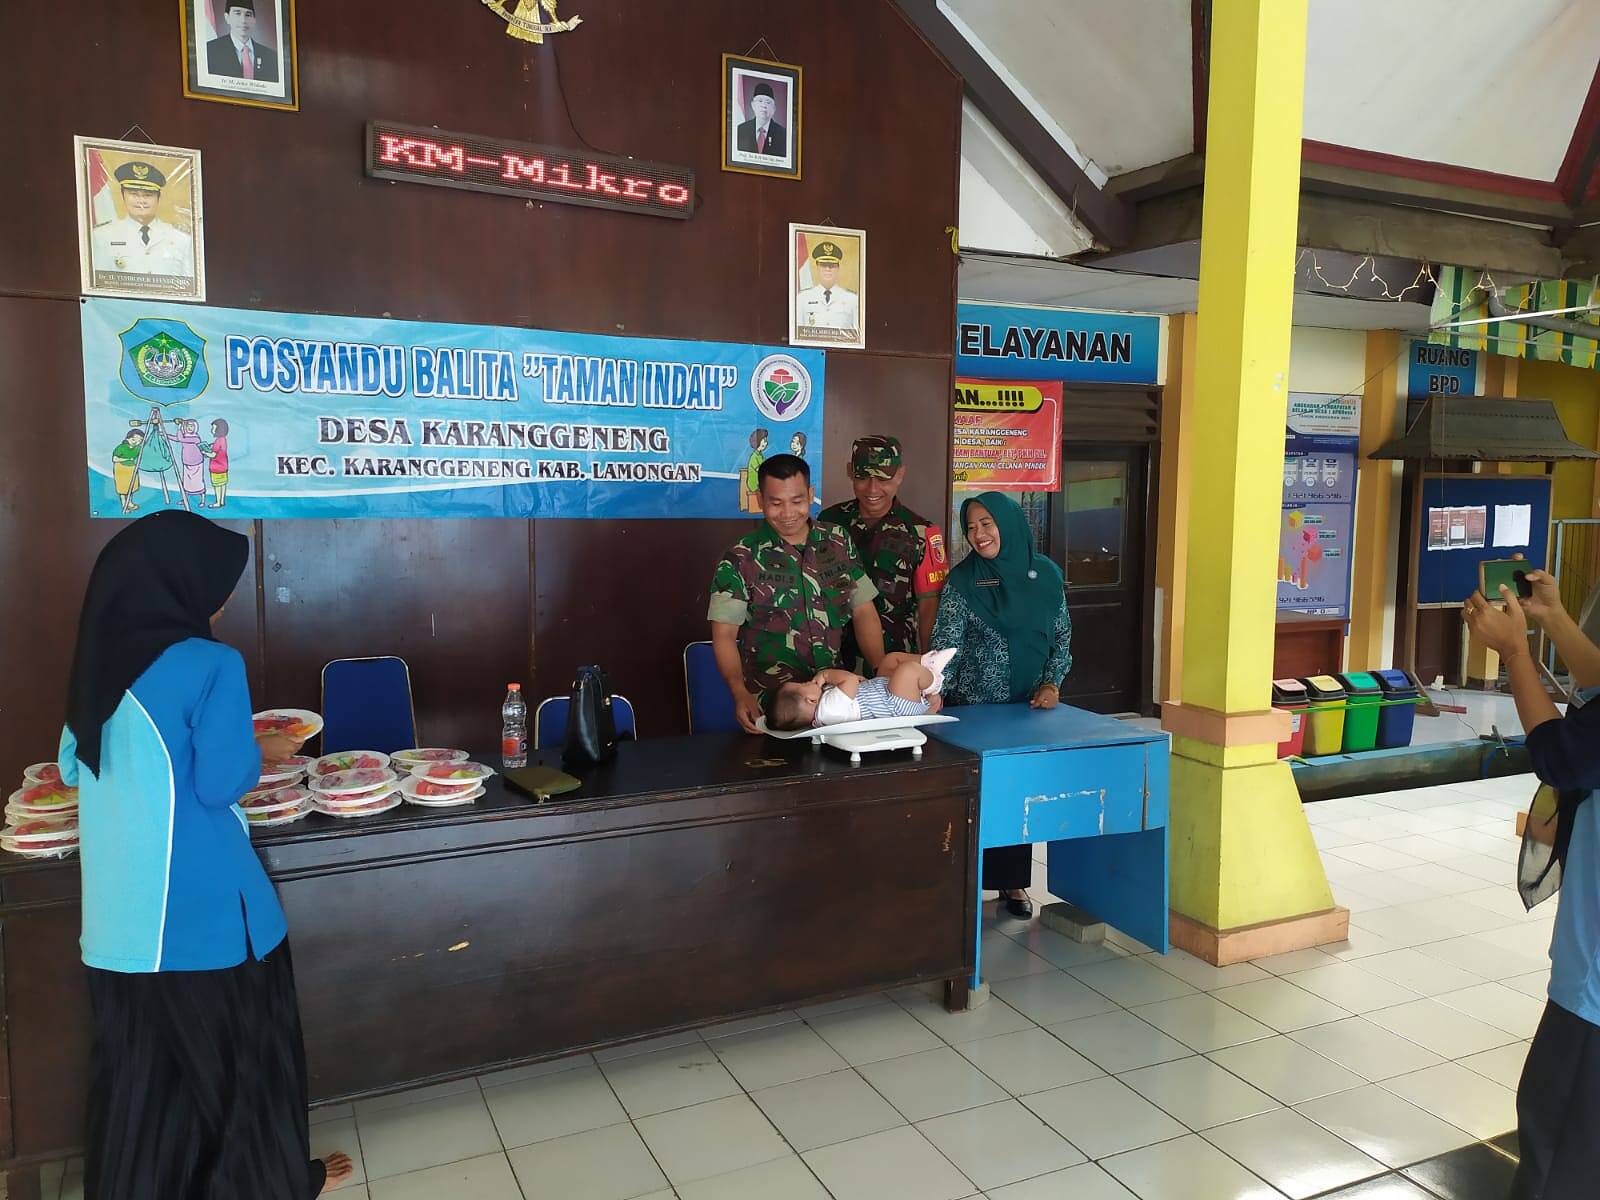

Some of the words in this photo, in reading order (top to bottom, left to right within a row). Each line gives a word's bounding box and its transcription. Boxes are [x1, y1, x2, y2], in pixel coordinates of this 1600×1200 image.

[225, 335, 406, 397] POSYANDU
[412, 347, 519, 401] BALITA
[1416, 346, 1471, 368] RUANG
[1429, 374, 1460, 394] BPD
[318, 417, 413, 446] DESA
[421, 420, 670, 453] KARANGGENENG
[969, 428, 1028, 437] KARANGGENENG
[277, 456, 335, 477] KEC.
[343, 457, 530, 479] KARANGGENENG
[537, 461, 586, 480] KAB.
[592, 463, 701, 482] LAMONGAN
